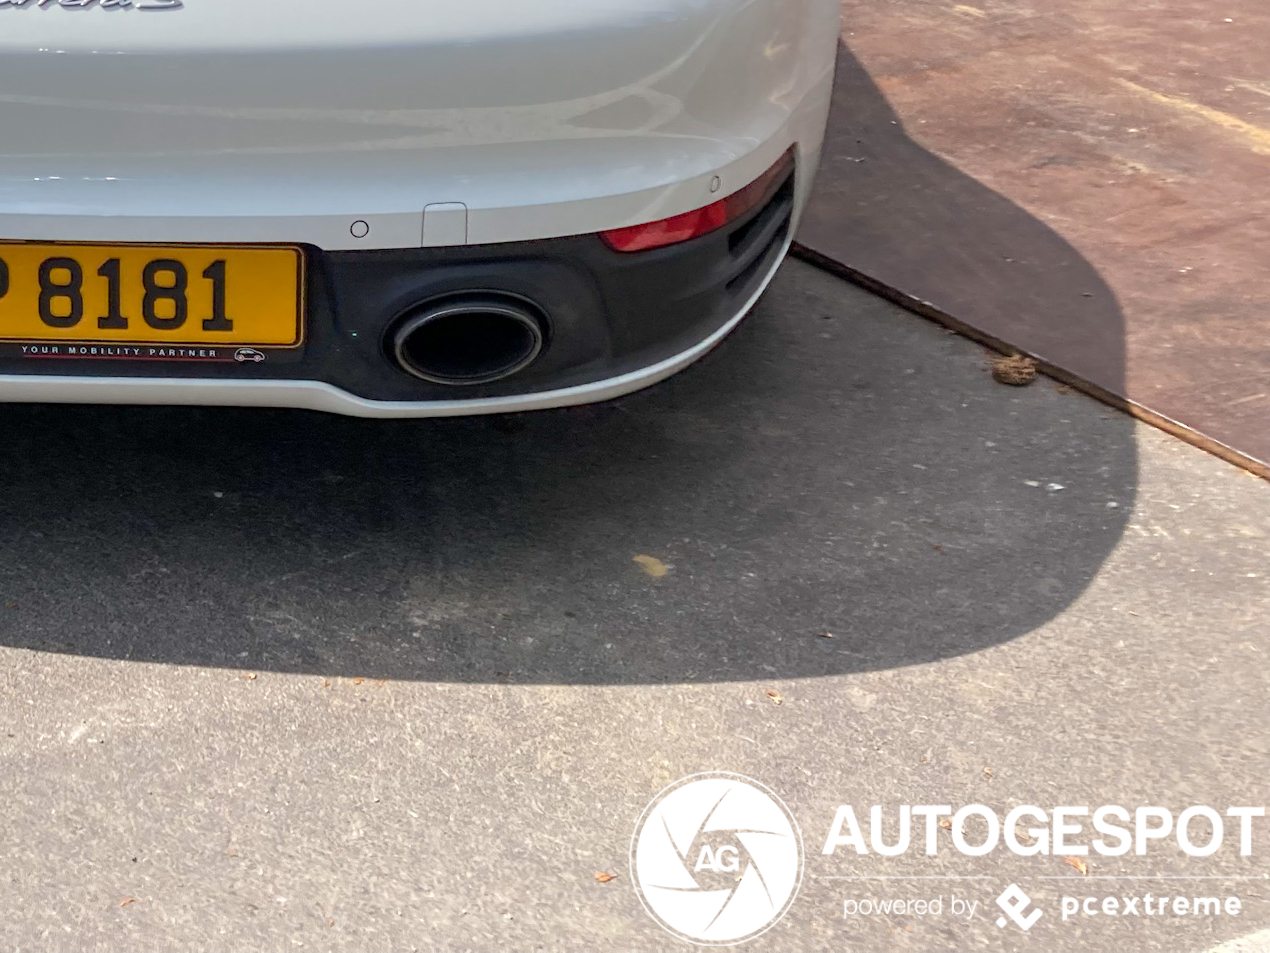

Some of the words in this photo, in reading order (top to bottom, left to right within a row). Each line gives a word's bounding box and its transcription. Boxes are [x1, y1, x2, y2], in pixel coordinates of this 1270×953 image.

[38, 257, 234, 332] 8181
[21, 346, 59, 354] YOUR
[68, 347, 140, 356] MOBILITY
[149, 349, 217, 357] PARTNER
